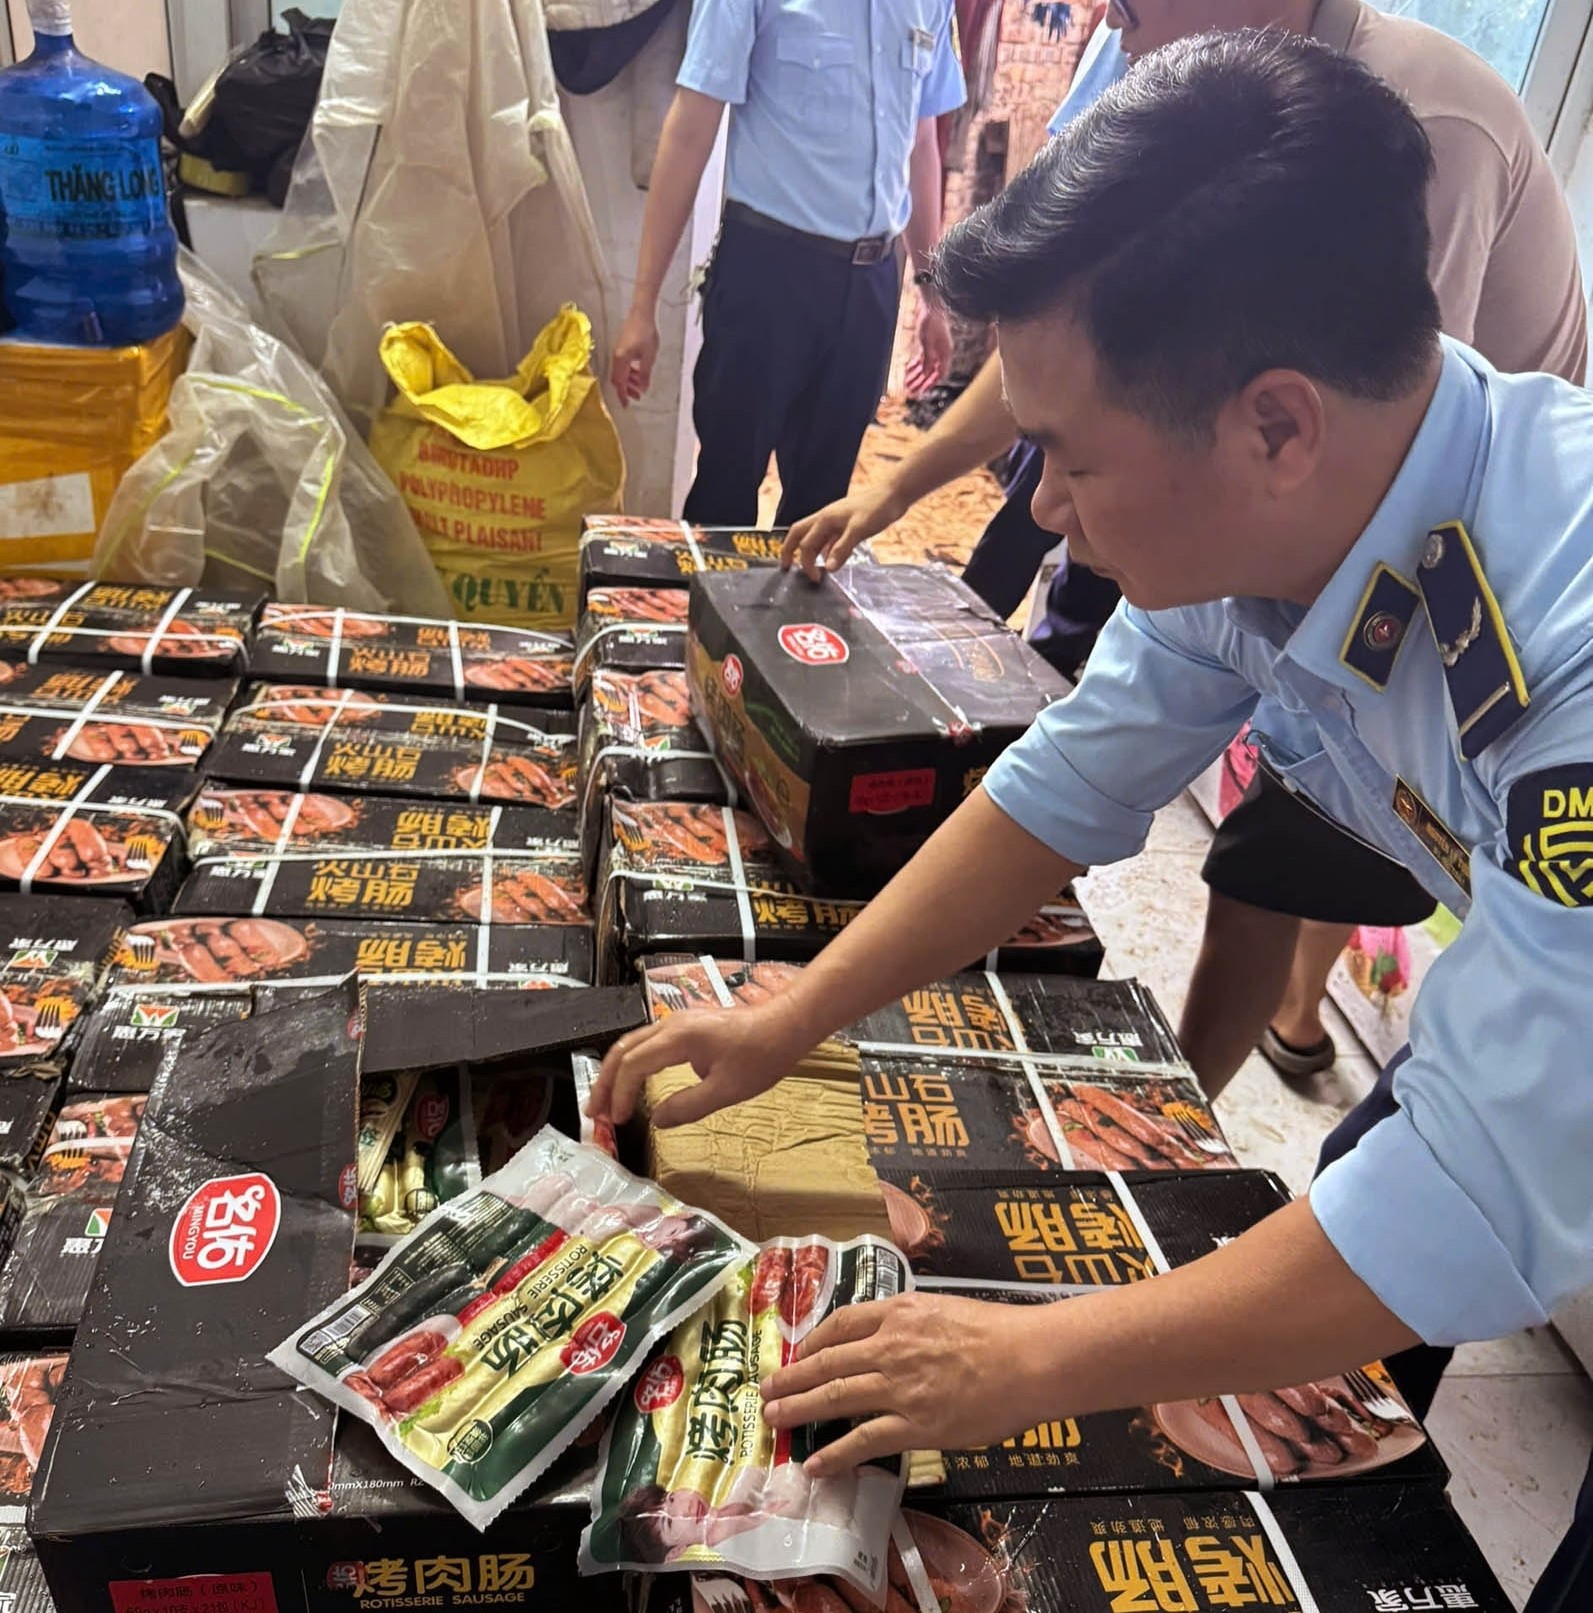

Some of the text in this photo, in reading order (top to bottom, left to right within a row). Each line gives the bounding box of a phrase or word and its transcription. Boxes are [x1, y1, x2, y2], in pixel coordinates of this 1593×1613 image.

[182, 1203, 205, 1260] MINGYOU
[527, 1244, 587, 1300] ROTISSERIE
[474, 1303, 529, 1351] SAUSAGE
[749, 1330, 763, 1386] AUSAGE
[352, 1553, 536, 1599] 烤肉肠
[360, 1591, 525, 1609] ROTISSERIE SAUSAGE
[1367, 1583, 1480, 1613] 惠万家
